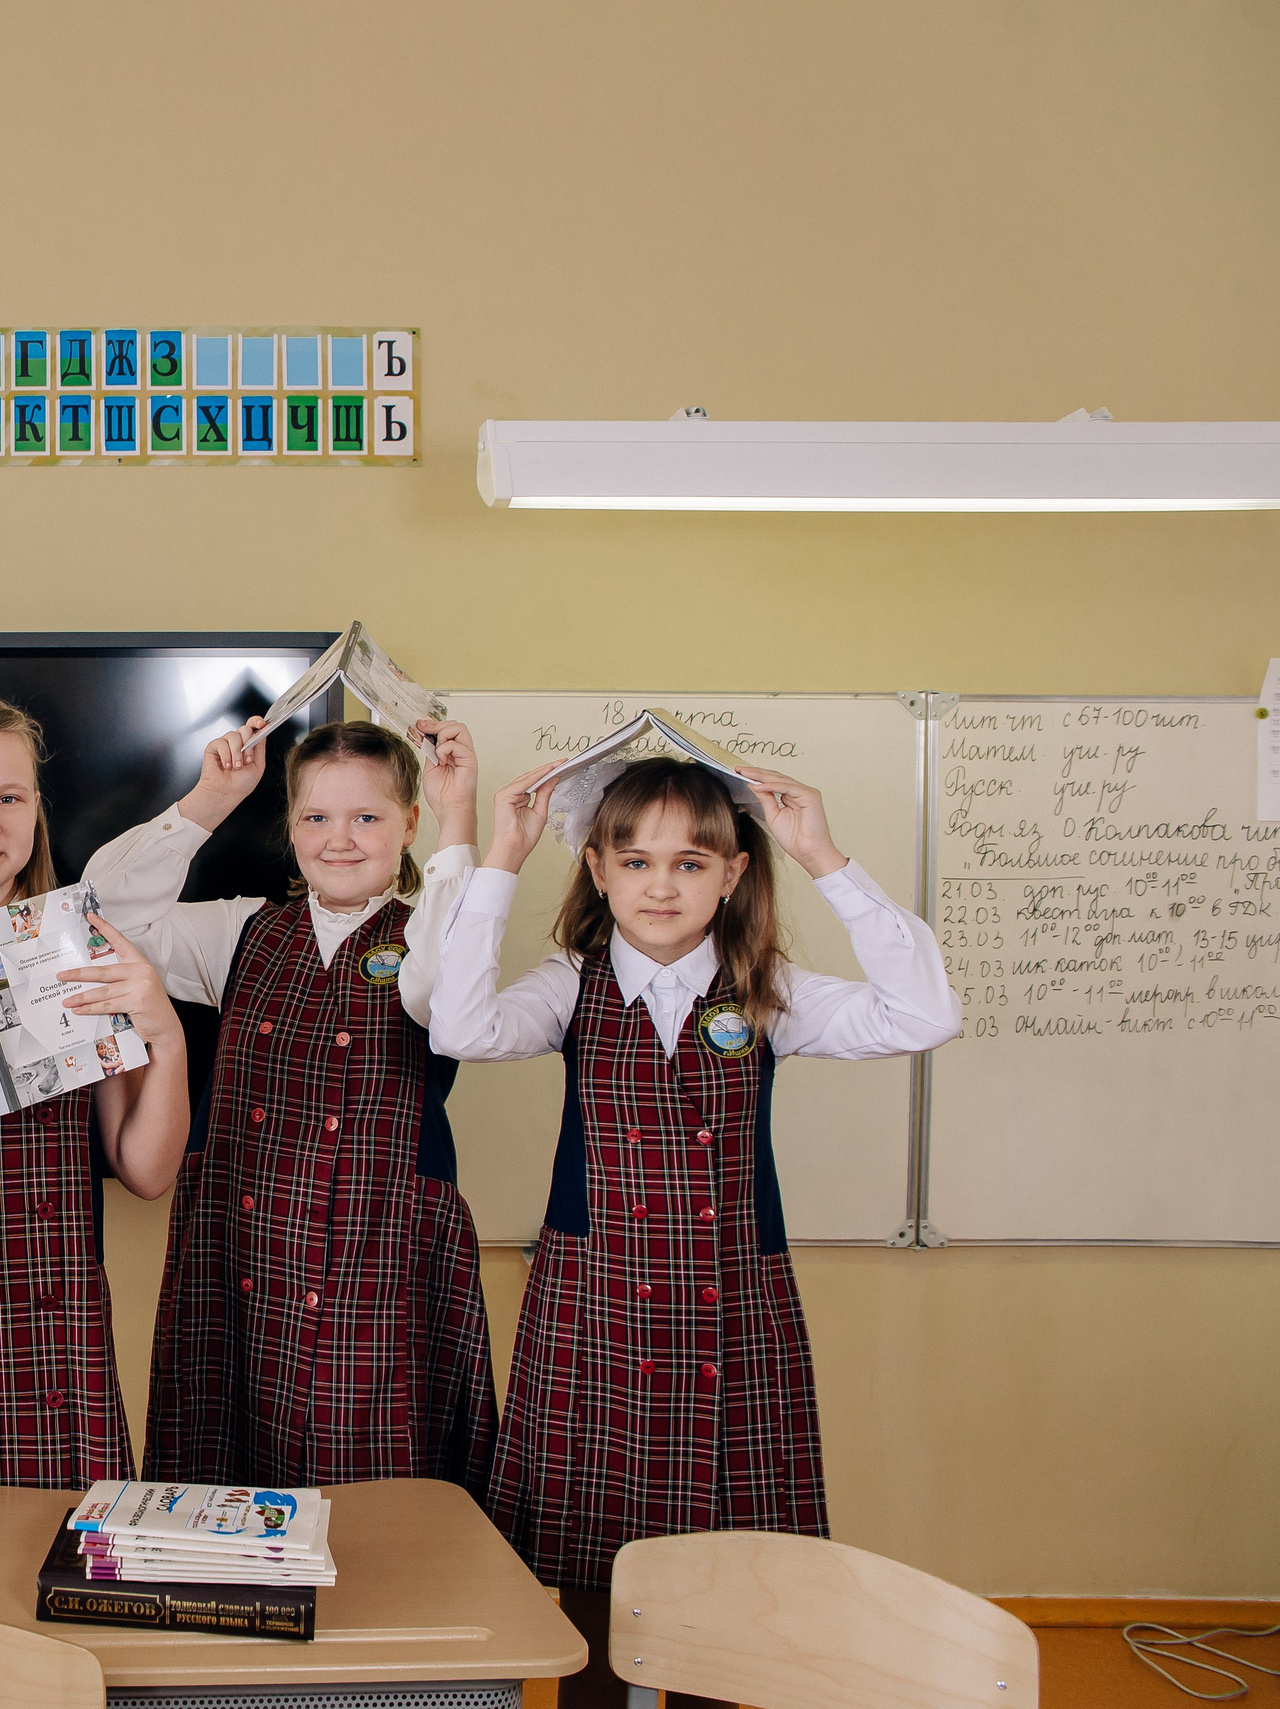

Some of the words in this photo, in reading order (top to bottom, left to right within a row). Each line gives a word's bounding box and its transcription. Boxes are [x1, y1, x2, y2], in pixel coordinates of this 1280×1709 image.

[17, 340, 43, 378] Г
[60, 339, 90, 384] Д
[107, 339, 135, 377] Ж
[152, 340, 178, 377] З
[378, 340, 406, 377] Ъ
[15, 404, 44, 443] К
[62, 404, 89, 442] Т
[105, 405, 134, 442] Ш
[152, 405, 180, 442] С
[199, 405, 228, 443] Х
[244, 405, 273, 450] Ц
[288, 405, 317, 443] Ч
[332, 404, 363, 450] Щ
[382, 405, 407, 442] Ь
[602, 699, 625, 725] 18
[1216, 852, 1260, 888] про
[30, 989, 62, 1005] светской
[62, 984, 83, 995] этики
[39, 980, 68, 993] Основы
[949, 984, 1009, 1006] 5.03
[59, 1012, 71, 1028] 4
[156, 1485, 180, 1511] СЛОВАРЬ
[85, 1598, 156, 1616] ОЖЕГОВ
[170, 1600, 216, 1614] ТОЛКОВЫЙ
[218, 1603, 255, 1617] СЛОВАРЬ
[176, 1613, 217, 1625] РУССКОГО
[219, 1616, 249, 1628] ЯЗЫКА
